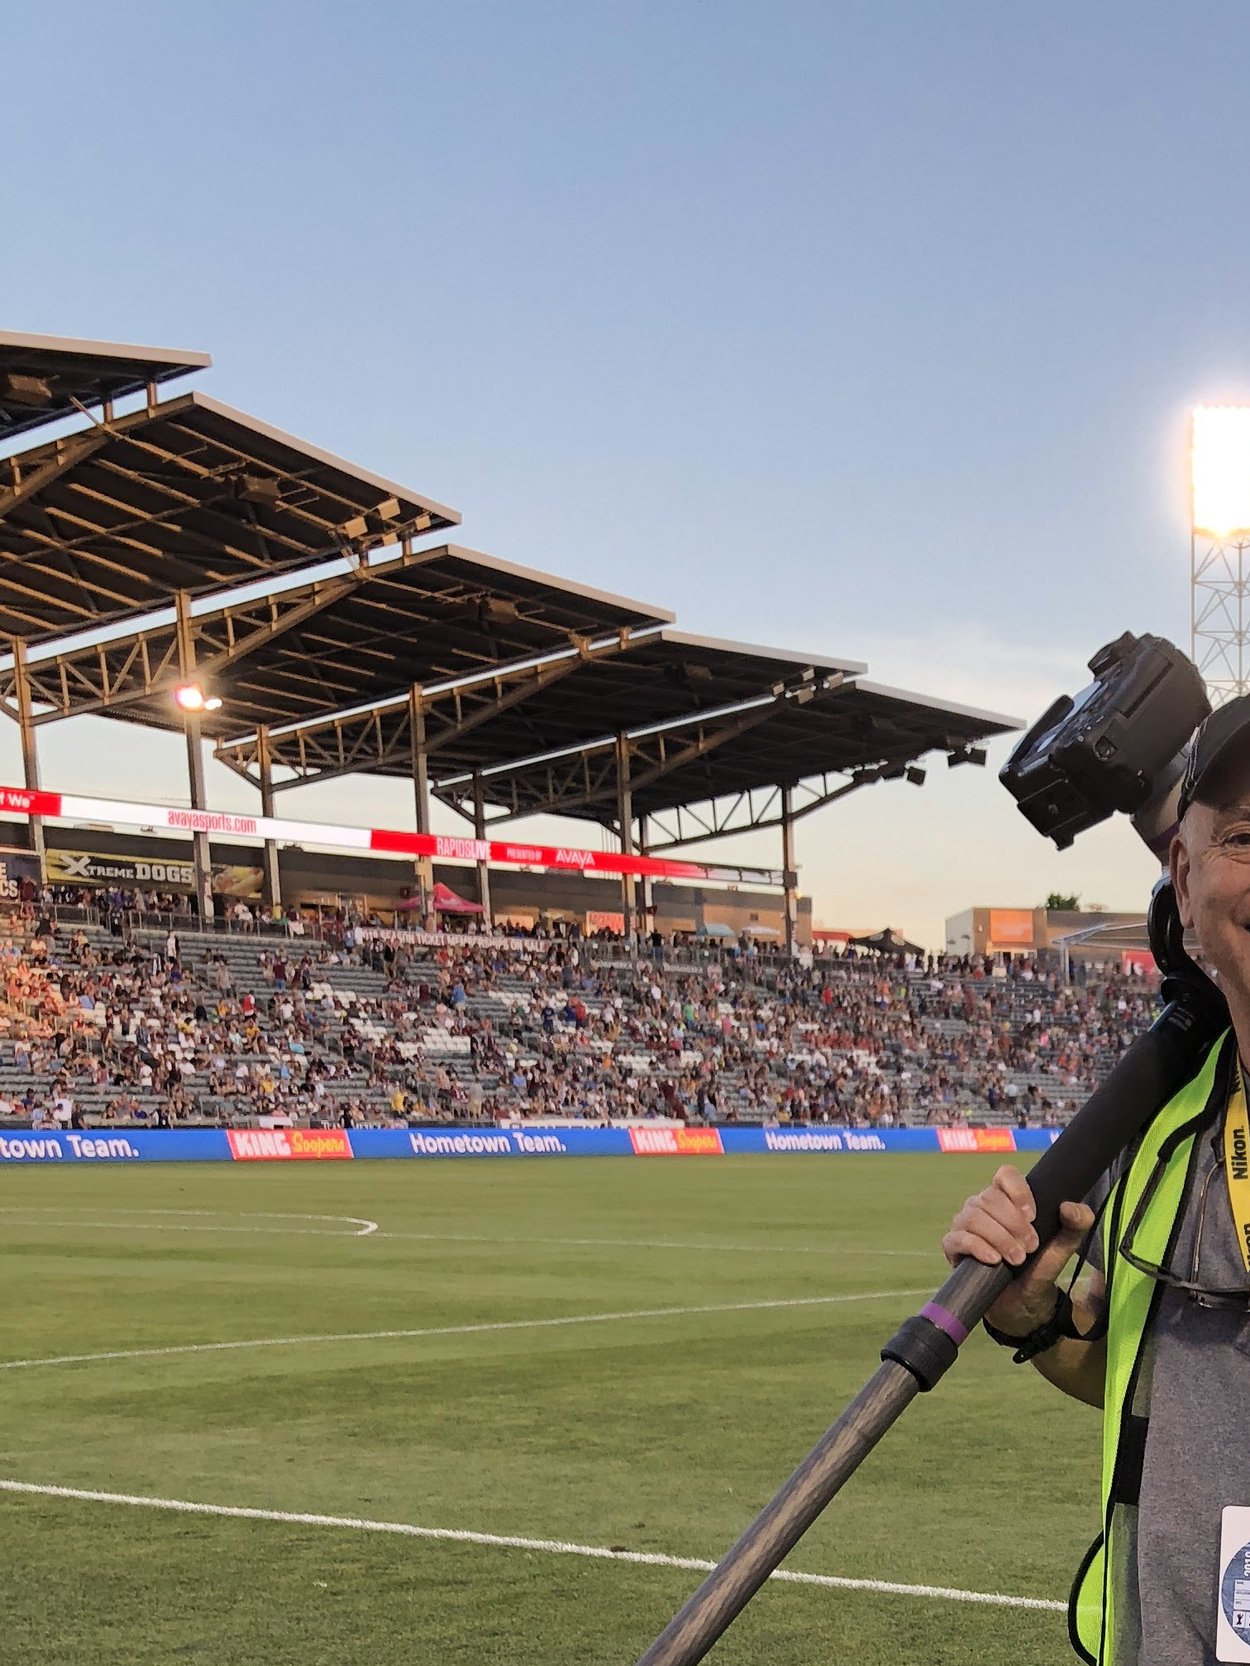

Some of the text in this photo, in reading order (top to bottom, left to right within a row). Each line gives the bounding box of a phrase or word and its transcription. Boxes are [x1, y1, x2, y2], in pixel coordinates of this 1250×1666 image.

[168, 809, 257, 834] avayasports.com
[555, 849, 595, 868] AVAYA
[135, 862, 195, 884] DOGS
[66, 1134, 140, 1158] Team.
[234, 1132, 292, 1157] KING
[410, 1131, 567, 1154] Hometown Team.
[635, 1131, 678, 1152] KING
[765, 1131, 887, 1151] Hometown Team.
[1232, 1125, 1249, 1181] Nikon
